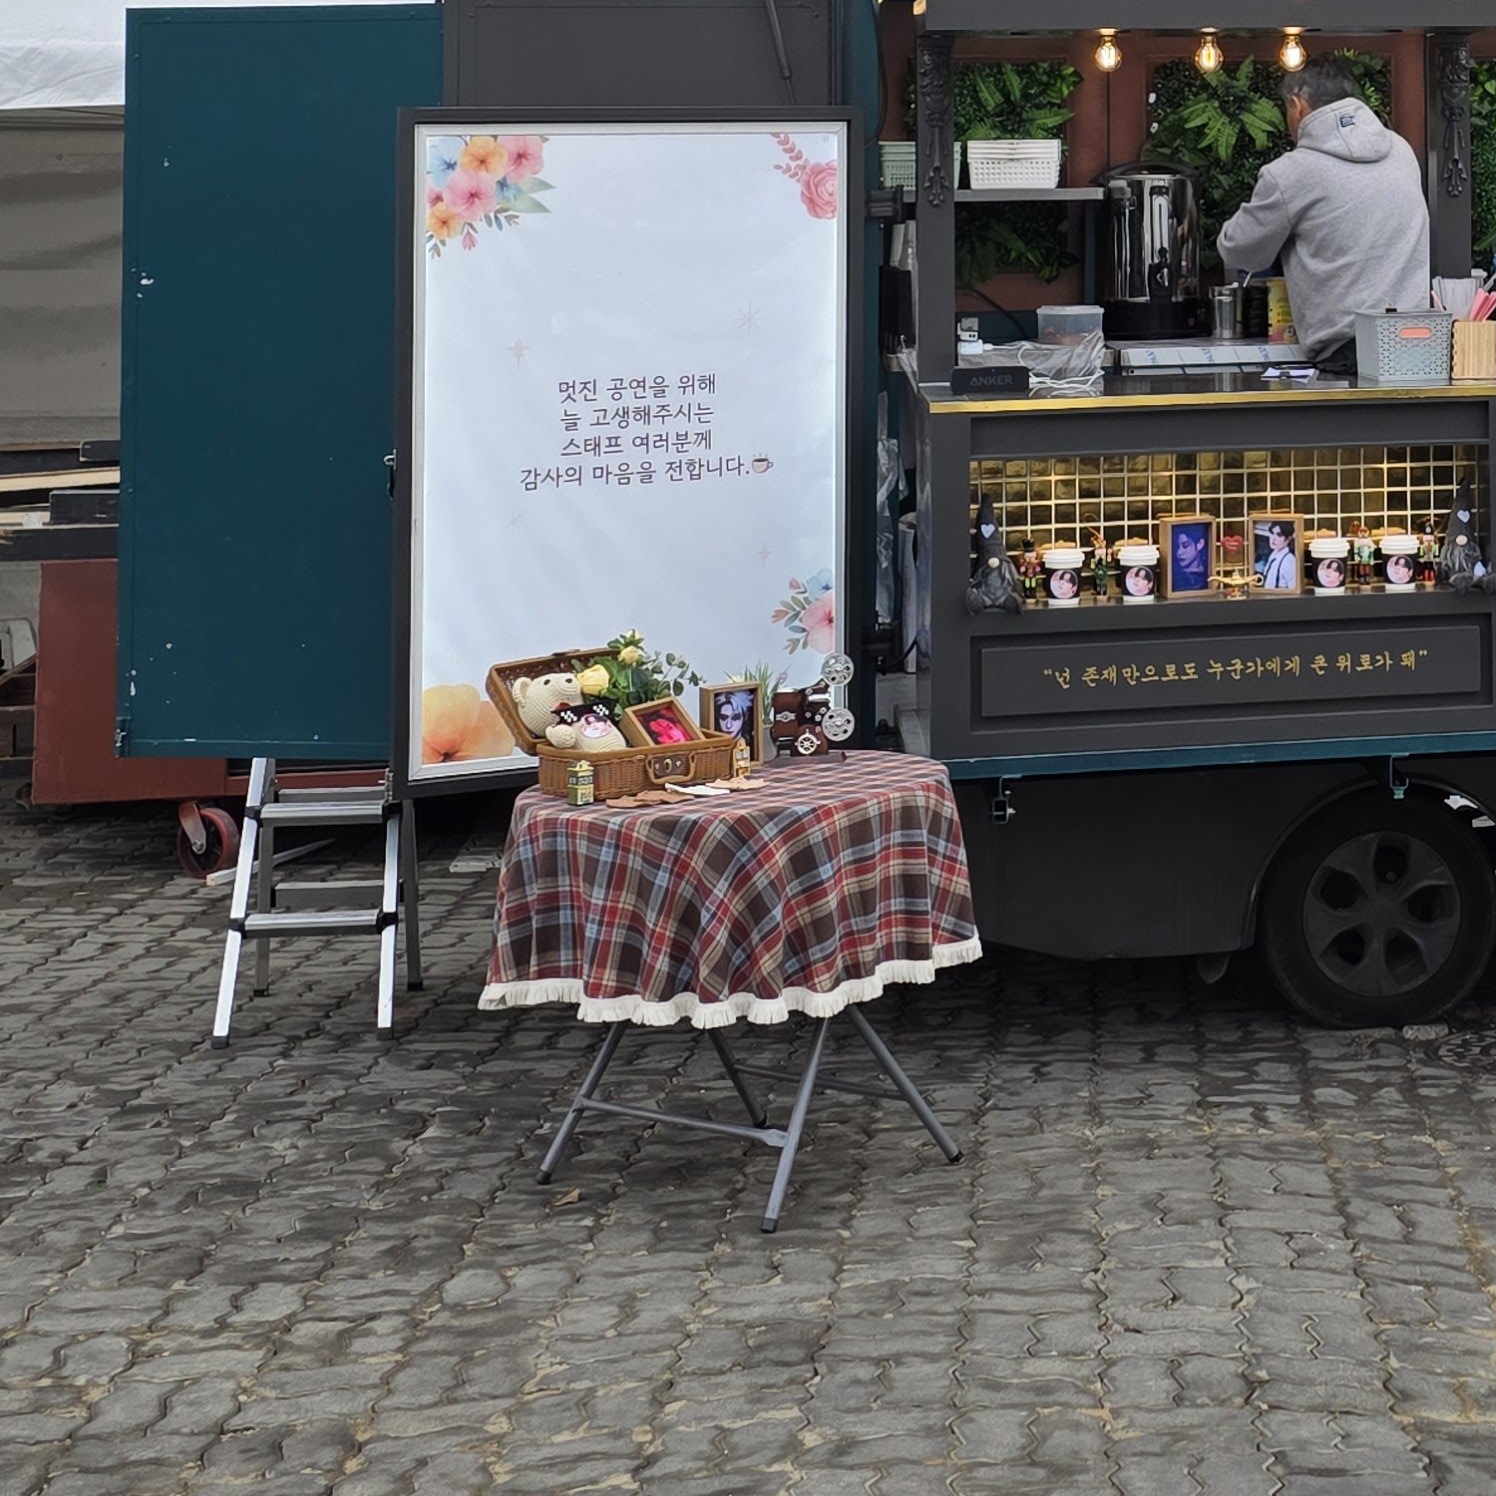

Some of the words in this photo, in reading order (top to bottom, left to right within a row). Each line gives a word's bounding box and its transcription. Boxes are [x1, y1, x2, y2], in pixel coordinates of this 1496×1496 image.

[557, 378, 599, 405] 멋진
[605, 375, 671, 402] 공연을
[676, 372, 717, 397] 위해
[969, 374, 1013, 387] ANKER
[559, 408, 583, 433] 늘
[588, 401, 716, 430] 고생해주시는
[559, 434, 625, 458] 스태프
[630, 428, 713, 456] 여러분께
[519, 464, 584, 493] 감사의
[591, 460, 658, 487] 마음을
[663, 454, 752, 483] 전합니다.
[1081, 662, 1200, 687] 존재만으로도
[1205, 655, 1301, 681] 누군가에게
[1309, 653, 1329, 676] 큰
[1335, 650, 1394, 675] 위로가
